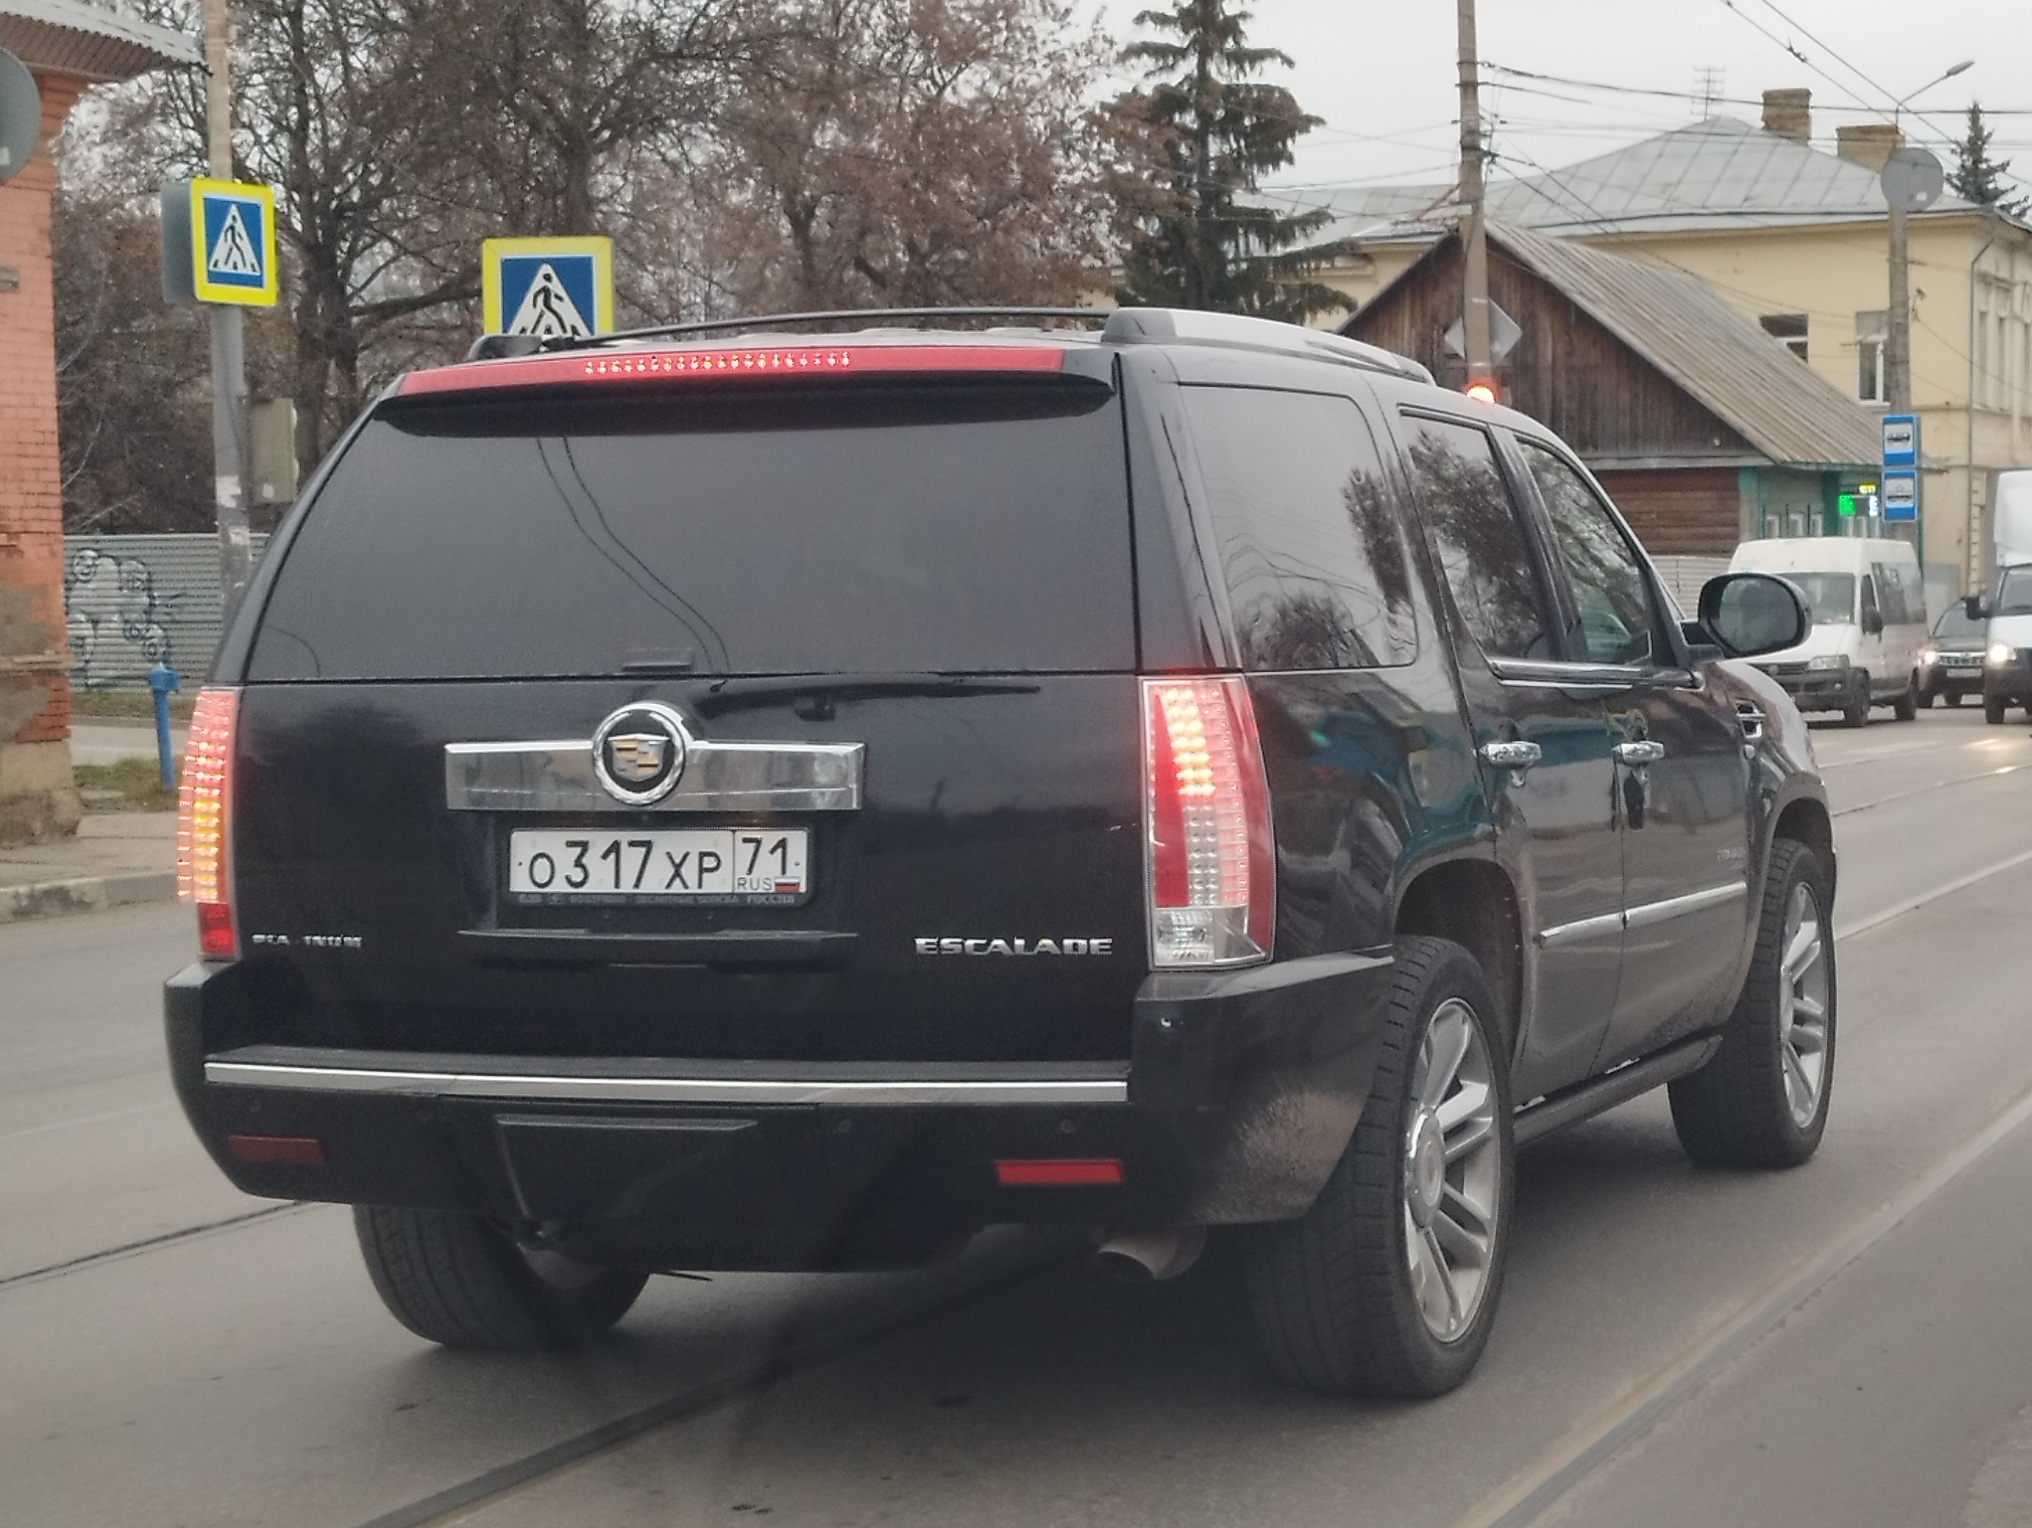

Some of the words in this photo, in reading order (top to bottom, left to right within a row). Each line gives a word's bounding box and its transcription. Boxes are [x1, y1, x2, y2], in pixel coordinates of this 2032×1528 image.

[741, 837, 789, 876] 71
[737, 876, 772, 891] RUS
[914, 936, 1114, 956] ESCALADE
